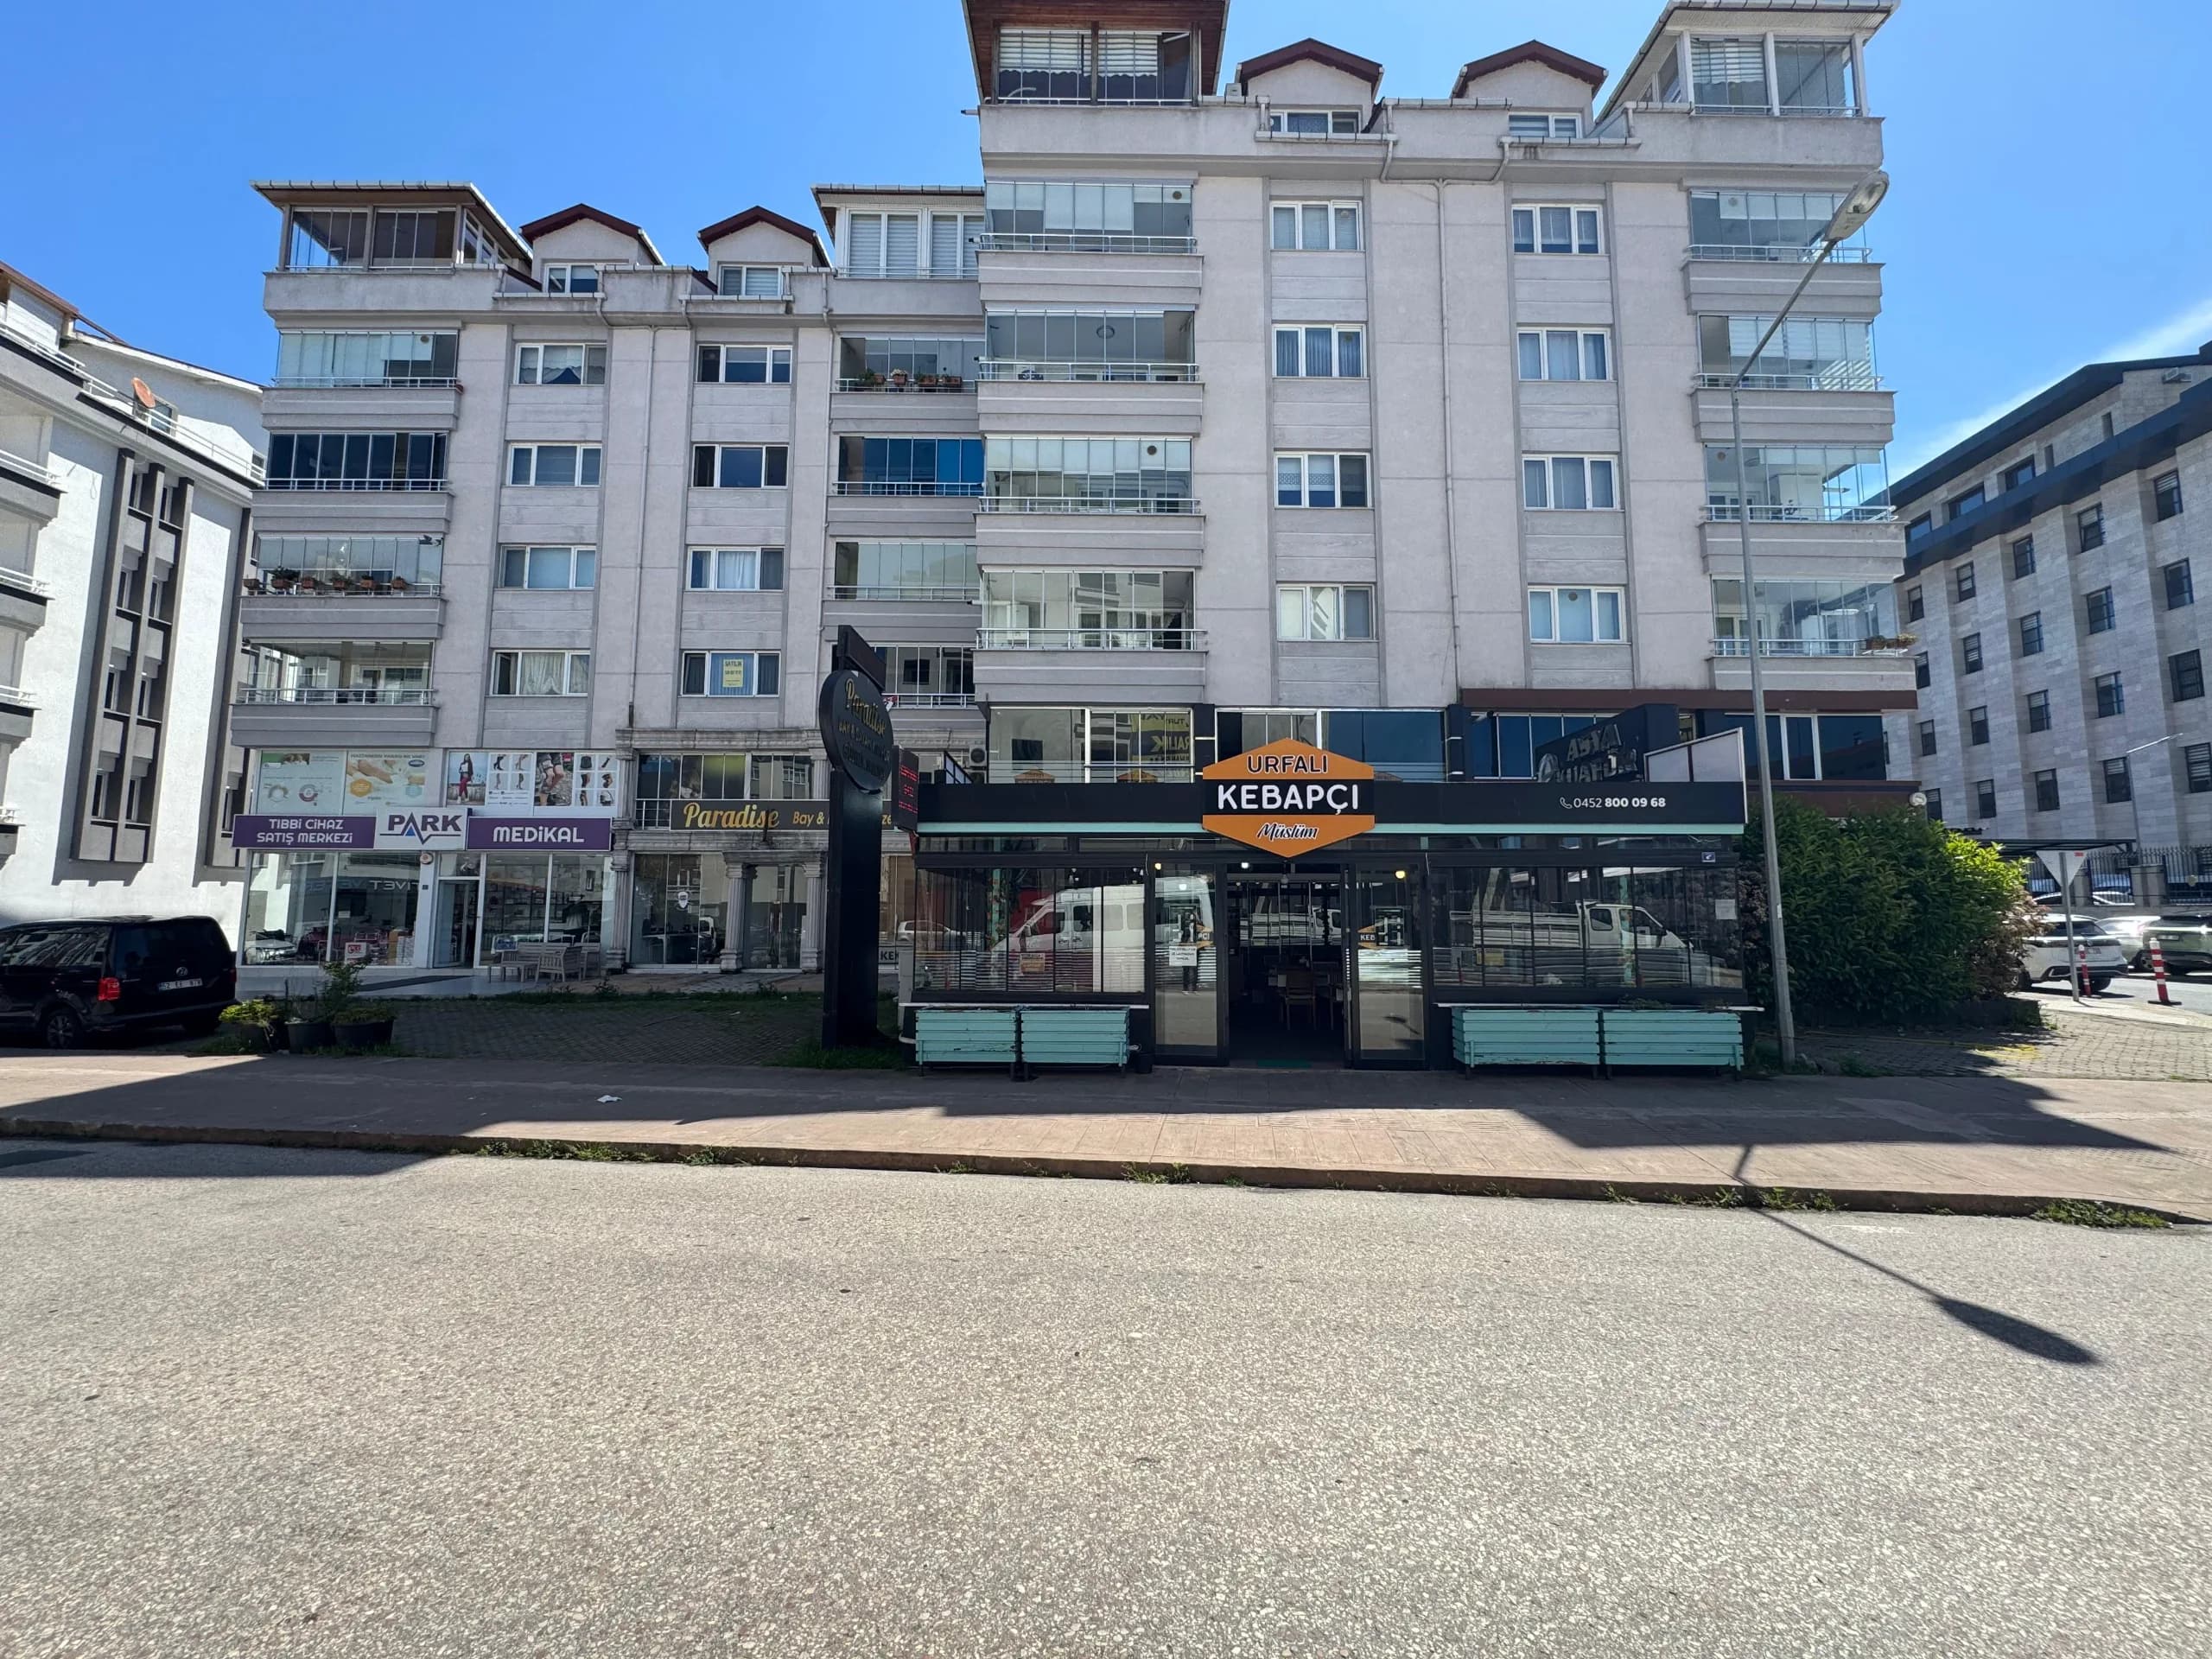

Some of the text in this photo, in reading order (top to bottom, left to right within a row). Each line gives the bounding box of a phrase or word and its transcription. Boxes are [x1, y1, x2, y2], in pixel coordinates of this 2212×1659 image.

[1247, 754, 1328, 775] URFALI
[1217, 784, 1359, 816] KEBAPÇI
[1573, 798, 1667, 809] 0452 800 09 68
[305, 819, 344, 830] CİHAZ
[387, 812, 461, 834] PARK
[683, 802, 780, 829] Paradise
[792, 810, 814, 827] Bay
[816, 811, 824, 825] &
[257, 832, 353, 845] SATIŞ MERKEZİ
[493, 825, 585, 843] MEDİKAL
[1256, 822, 1319, 842] Müslüm
